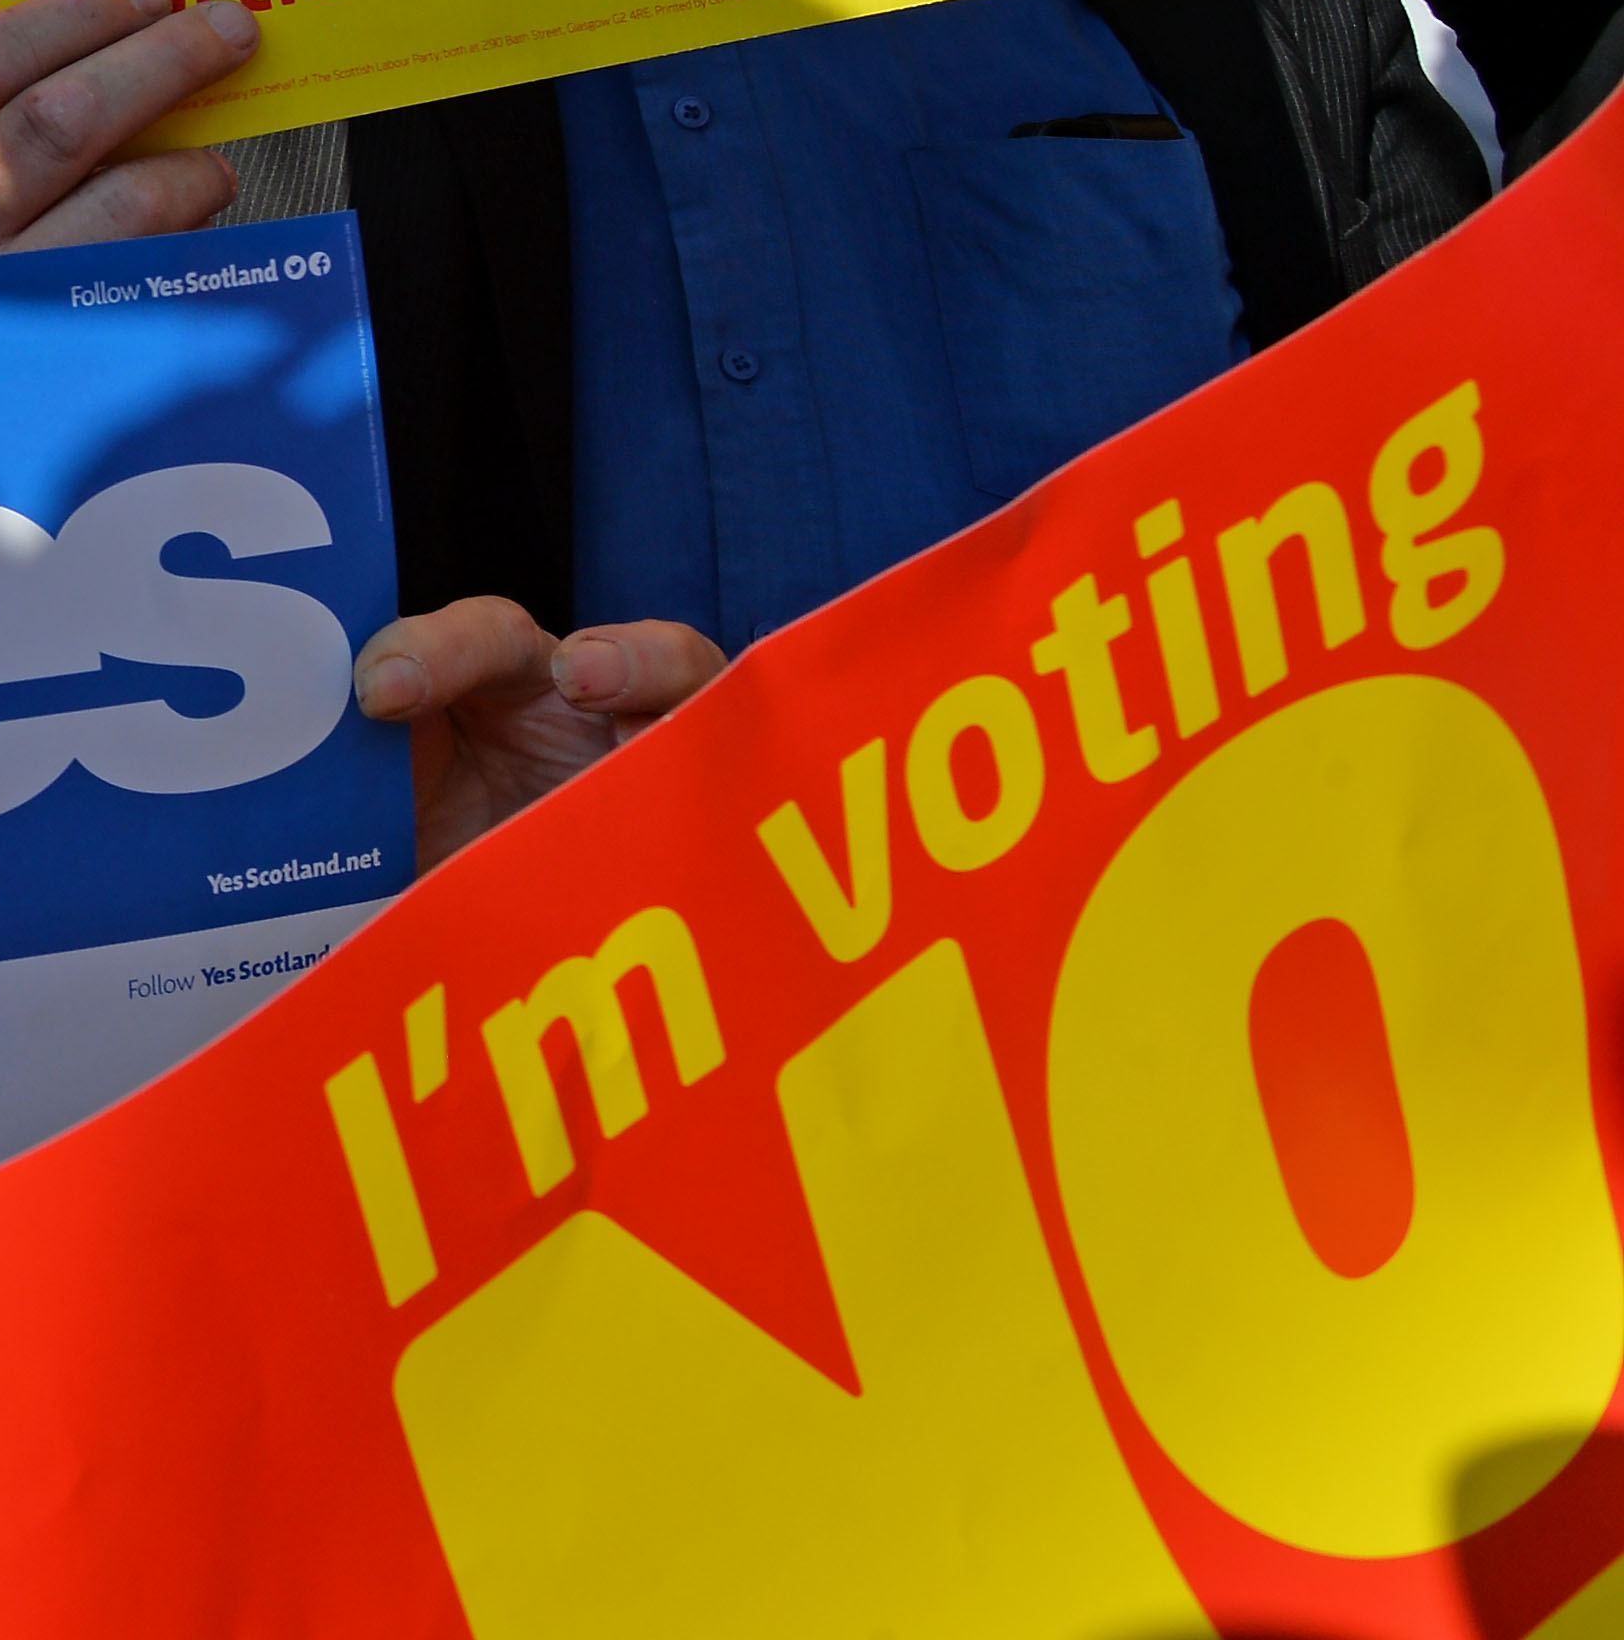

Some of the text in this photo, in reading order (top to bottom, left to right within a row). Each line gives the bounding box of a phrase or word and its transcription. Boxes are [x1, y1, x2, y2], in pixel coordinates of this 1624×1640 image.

[332, 64, 374, 81] Scottish
[654, 0, 693, 16] Printed
[71, 280, 141, 308] Follow
[322, 376, 1509, 1310] I'm voting
[127, 973, 196, 1000] Follow
[392, 673, 1624, 1640] NO
